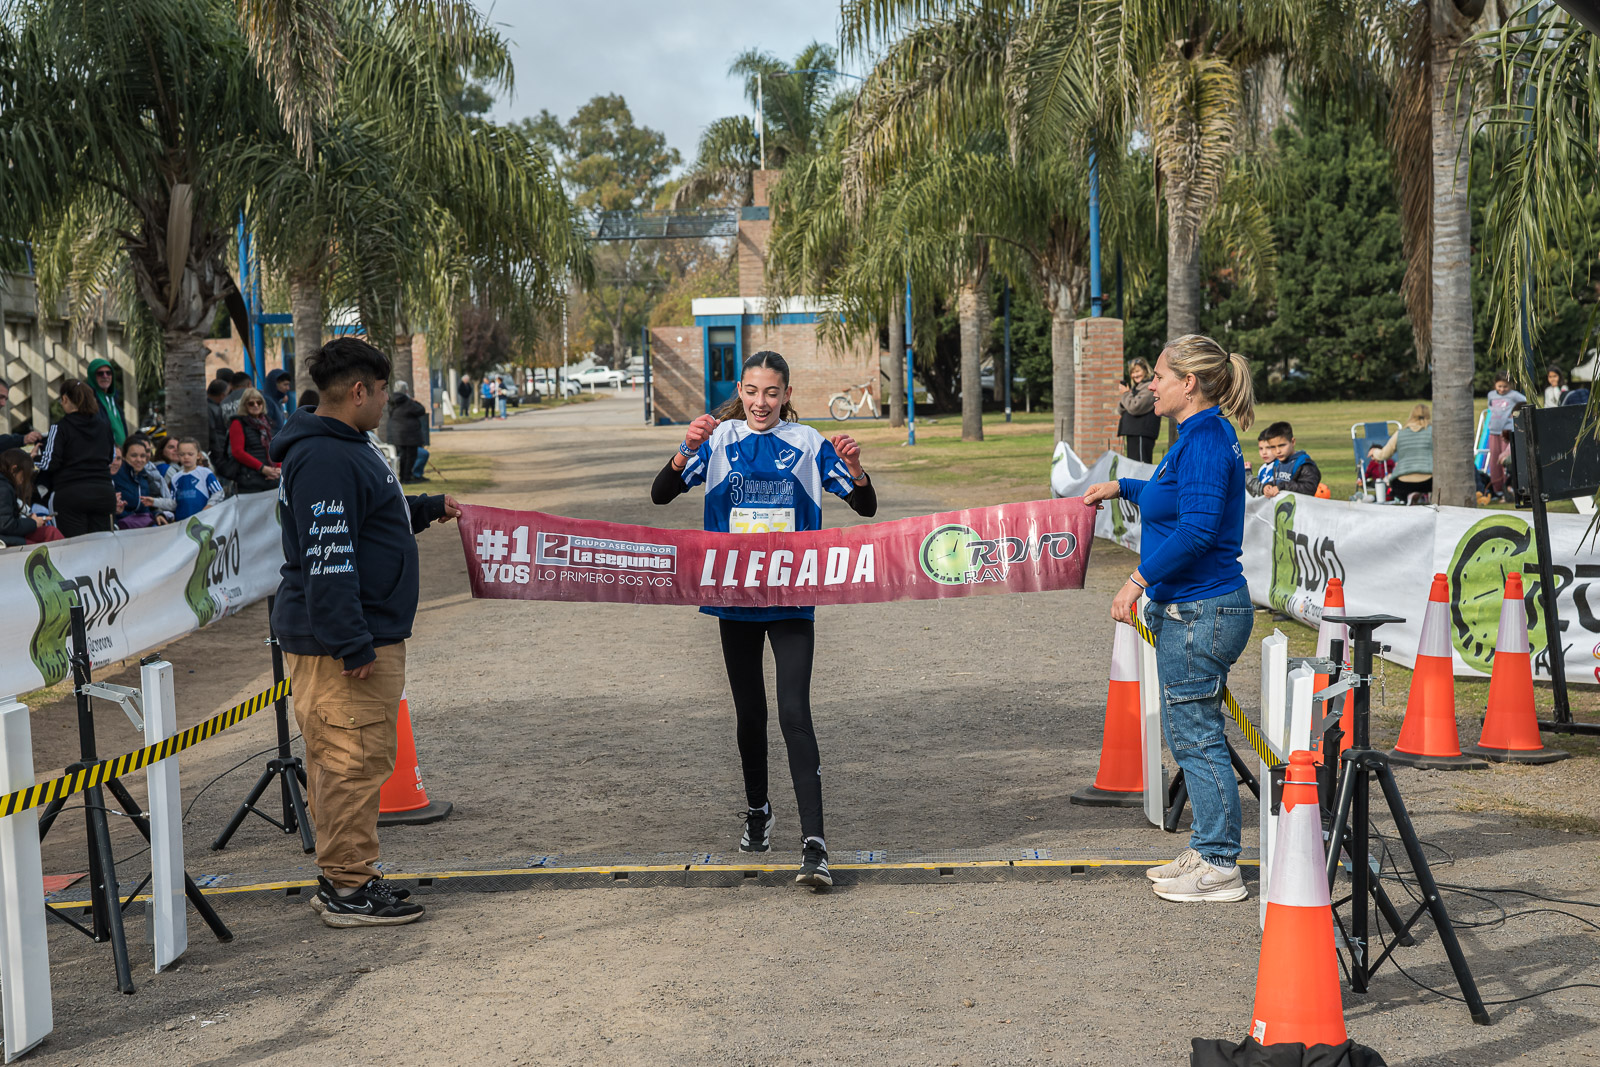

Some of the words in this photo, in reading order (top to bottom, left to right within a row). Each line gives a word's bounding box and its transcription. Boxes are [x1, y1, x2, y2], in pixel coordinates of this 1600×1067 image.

[729, 472, 744, 506] 3
[745, 479, 795, 495] MARATÓN
[311, 500, 325, 517] El
[309, 521, 319, 535] de
[319, 520, 349, 540] pueblo
[306, 544, 322, 556] más
[476, 525, 531, 563] #1
[574, 539, 606, 548] GRUPO
[608, 543, 672, 553] ASEGURADOR
[310, 561, 322, 575] del
[594, 553, 671, 568] segunda
[700, 544, 875, 588] LLEGADA
[481, 563, 530, 584] VOS
[538, 569, 557, 581] LO
[560, 570, 615, 584] PRIMERO
[618, 574, 643, 586] SOS
[646, 575, 673, 587] VOS
[964, 566, 1010, 584] RAV
